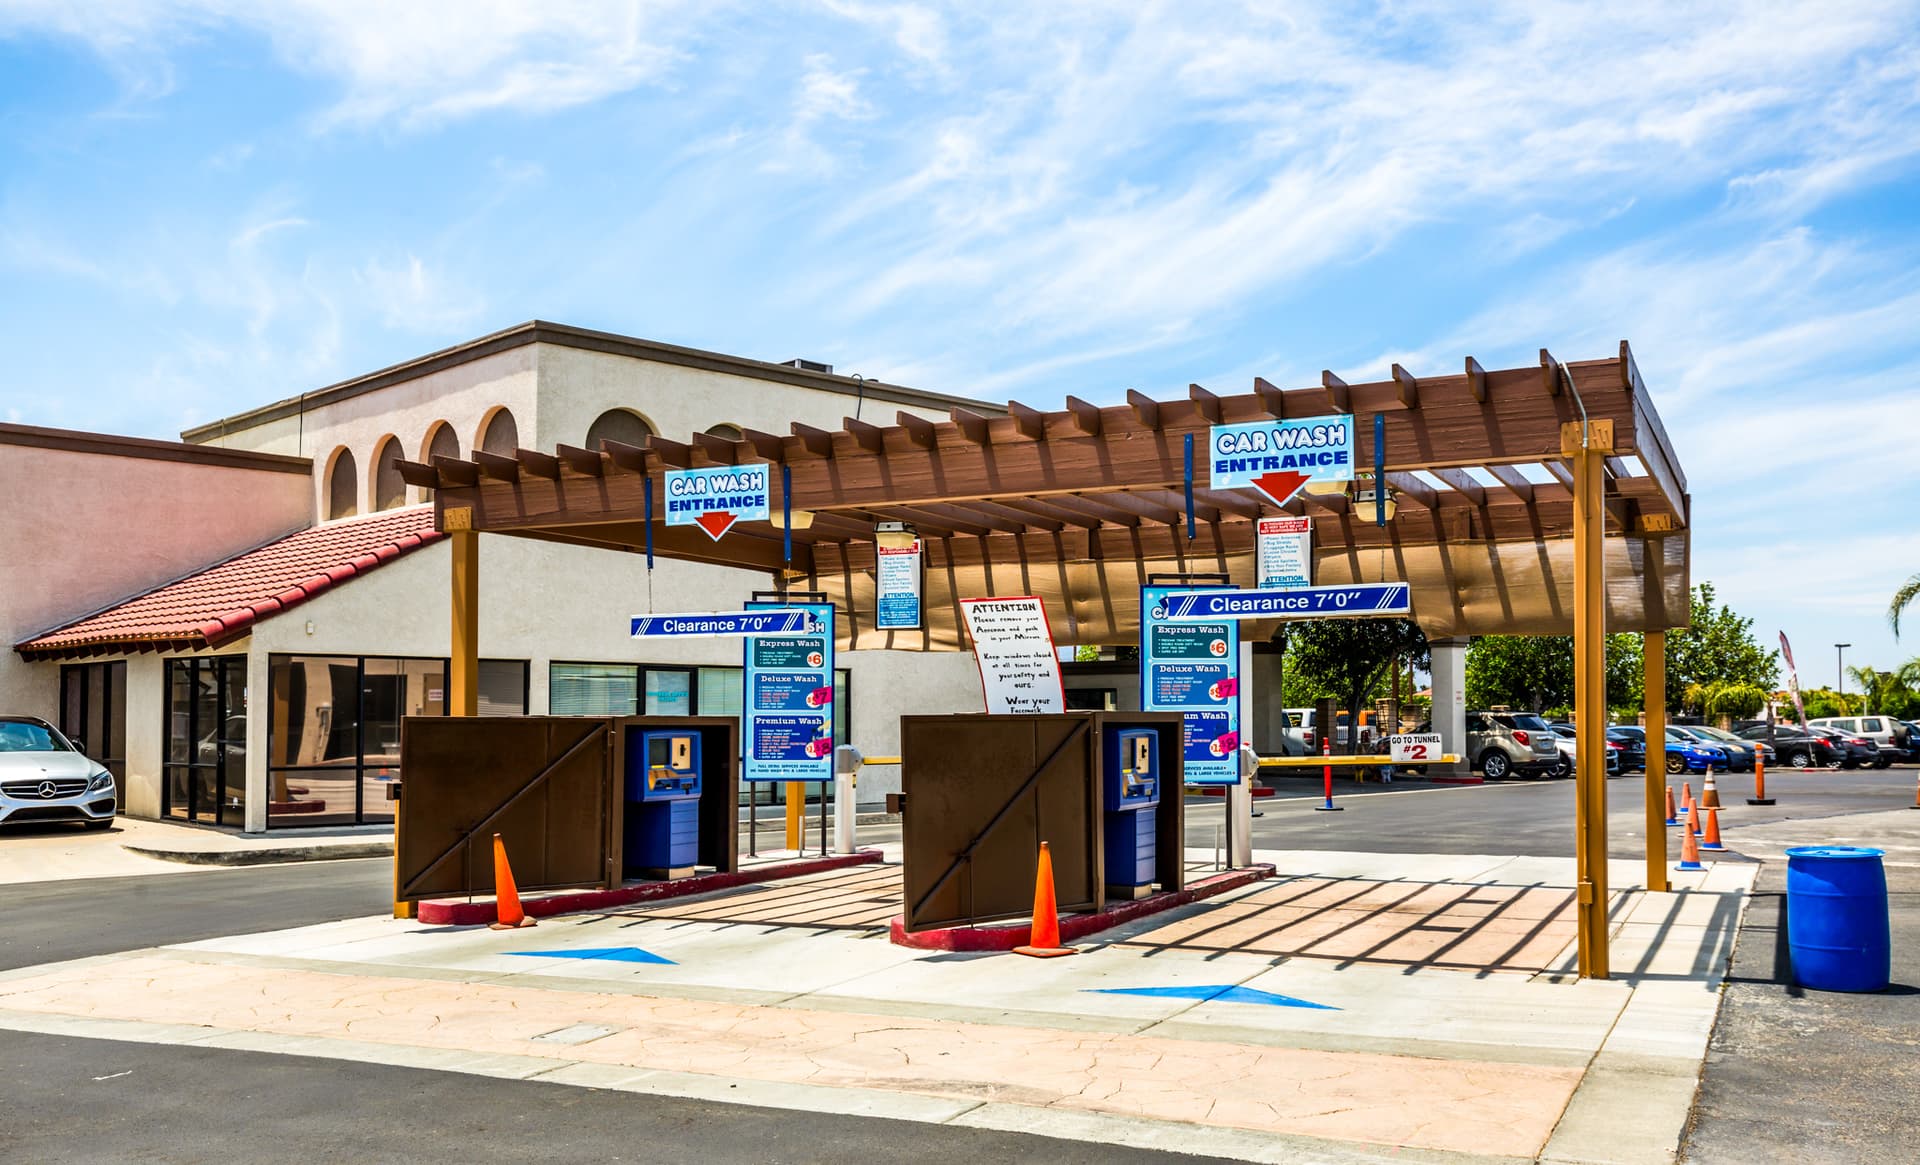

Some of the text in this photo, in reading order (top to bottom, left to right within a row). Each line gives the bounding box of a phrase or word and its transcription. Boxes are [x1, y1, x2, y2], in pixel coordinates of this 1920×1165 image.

[1217, 424, 1346, 454] CAR WASH
[1216, 451, 1348, 473] ENTRANCE
[670, 472, 763, 496] CAR WASH
[669, 495, 764, 512] ENTRANCE
[973, 603, 1036, 613] ATTENTION
[1210, 595, 1309, 612] Clearance
[663, 619, 735, 632] Clearance
[1157, 626, 1196, 635] Express
[759, 640, 795, 648] Express
[1211, 642, 1225, 653] $6
[983, 652, 1000, 660] Keep
[999, 673, 1012, 682] your
[1013, 672, 1035, 681] safety
[1005, 696, 1051, 708] Wear your
[755, 717, 822, 725] Premium Wash
[1201, 712, 1227, 720] Wash
[1392, 736, 1401, 744] GO
[1414, 735, 1440, 743] TUNNEL
[1403, 744, 1428, 760] #2
